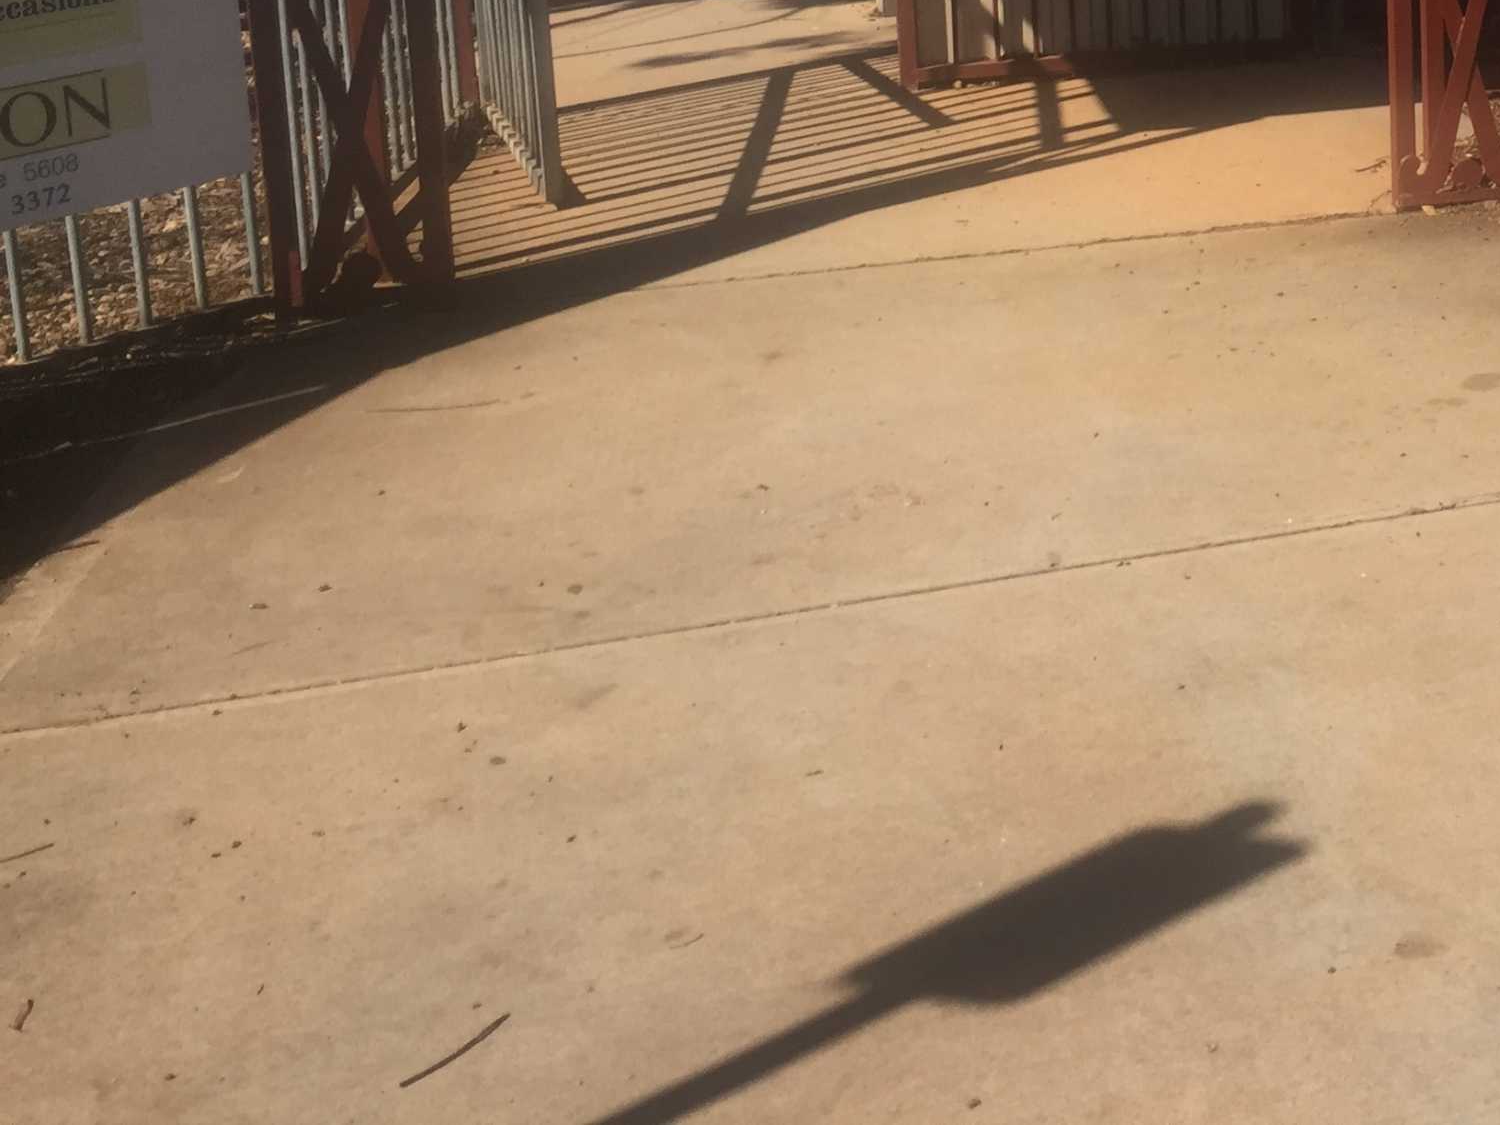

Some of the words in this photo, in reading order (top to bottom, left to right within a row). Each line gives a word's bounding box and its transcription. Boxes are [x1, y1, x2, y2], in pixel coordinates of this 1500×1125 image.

[0, 76, 111, 148] ON
[23, 153, 80, 181] 5608
[11, 182, 72, 215] 3372
